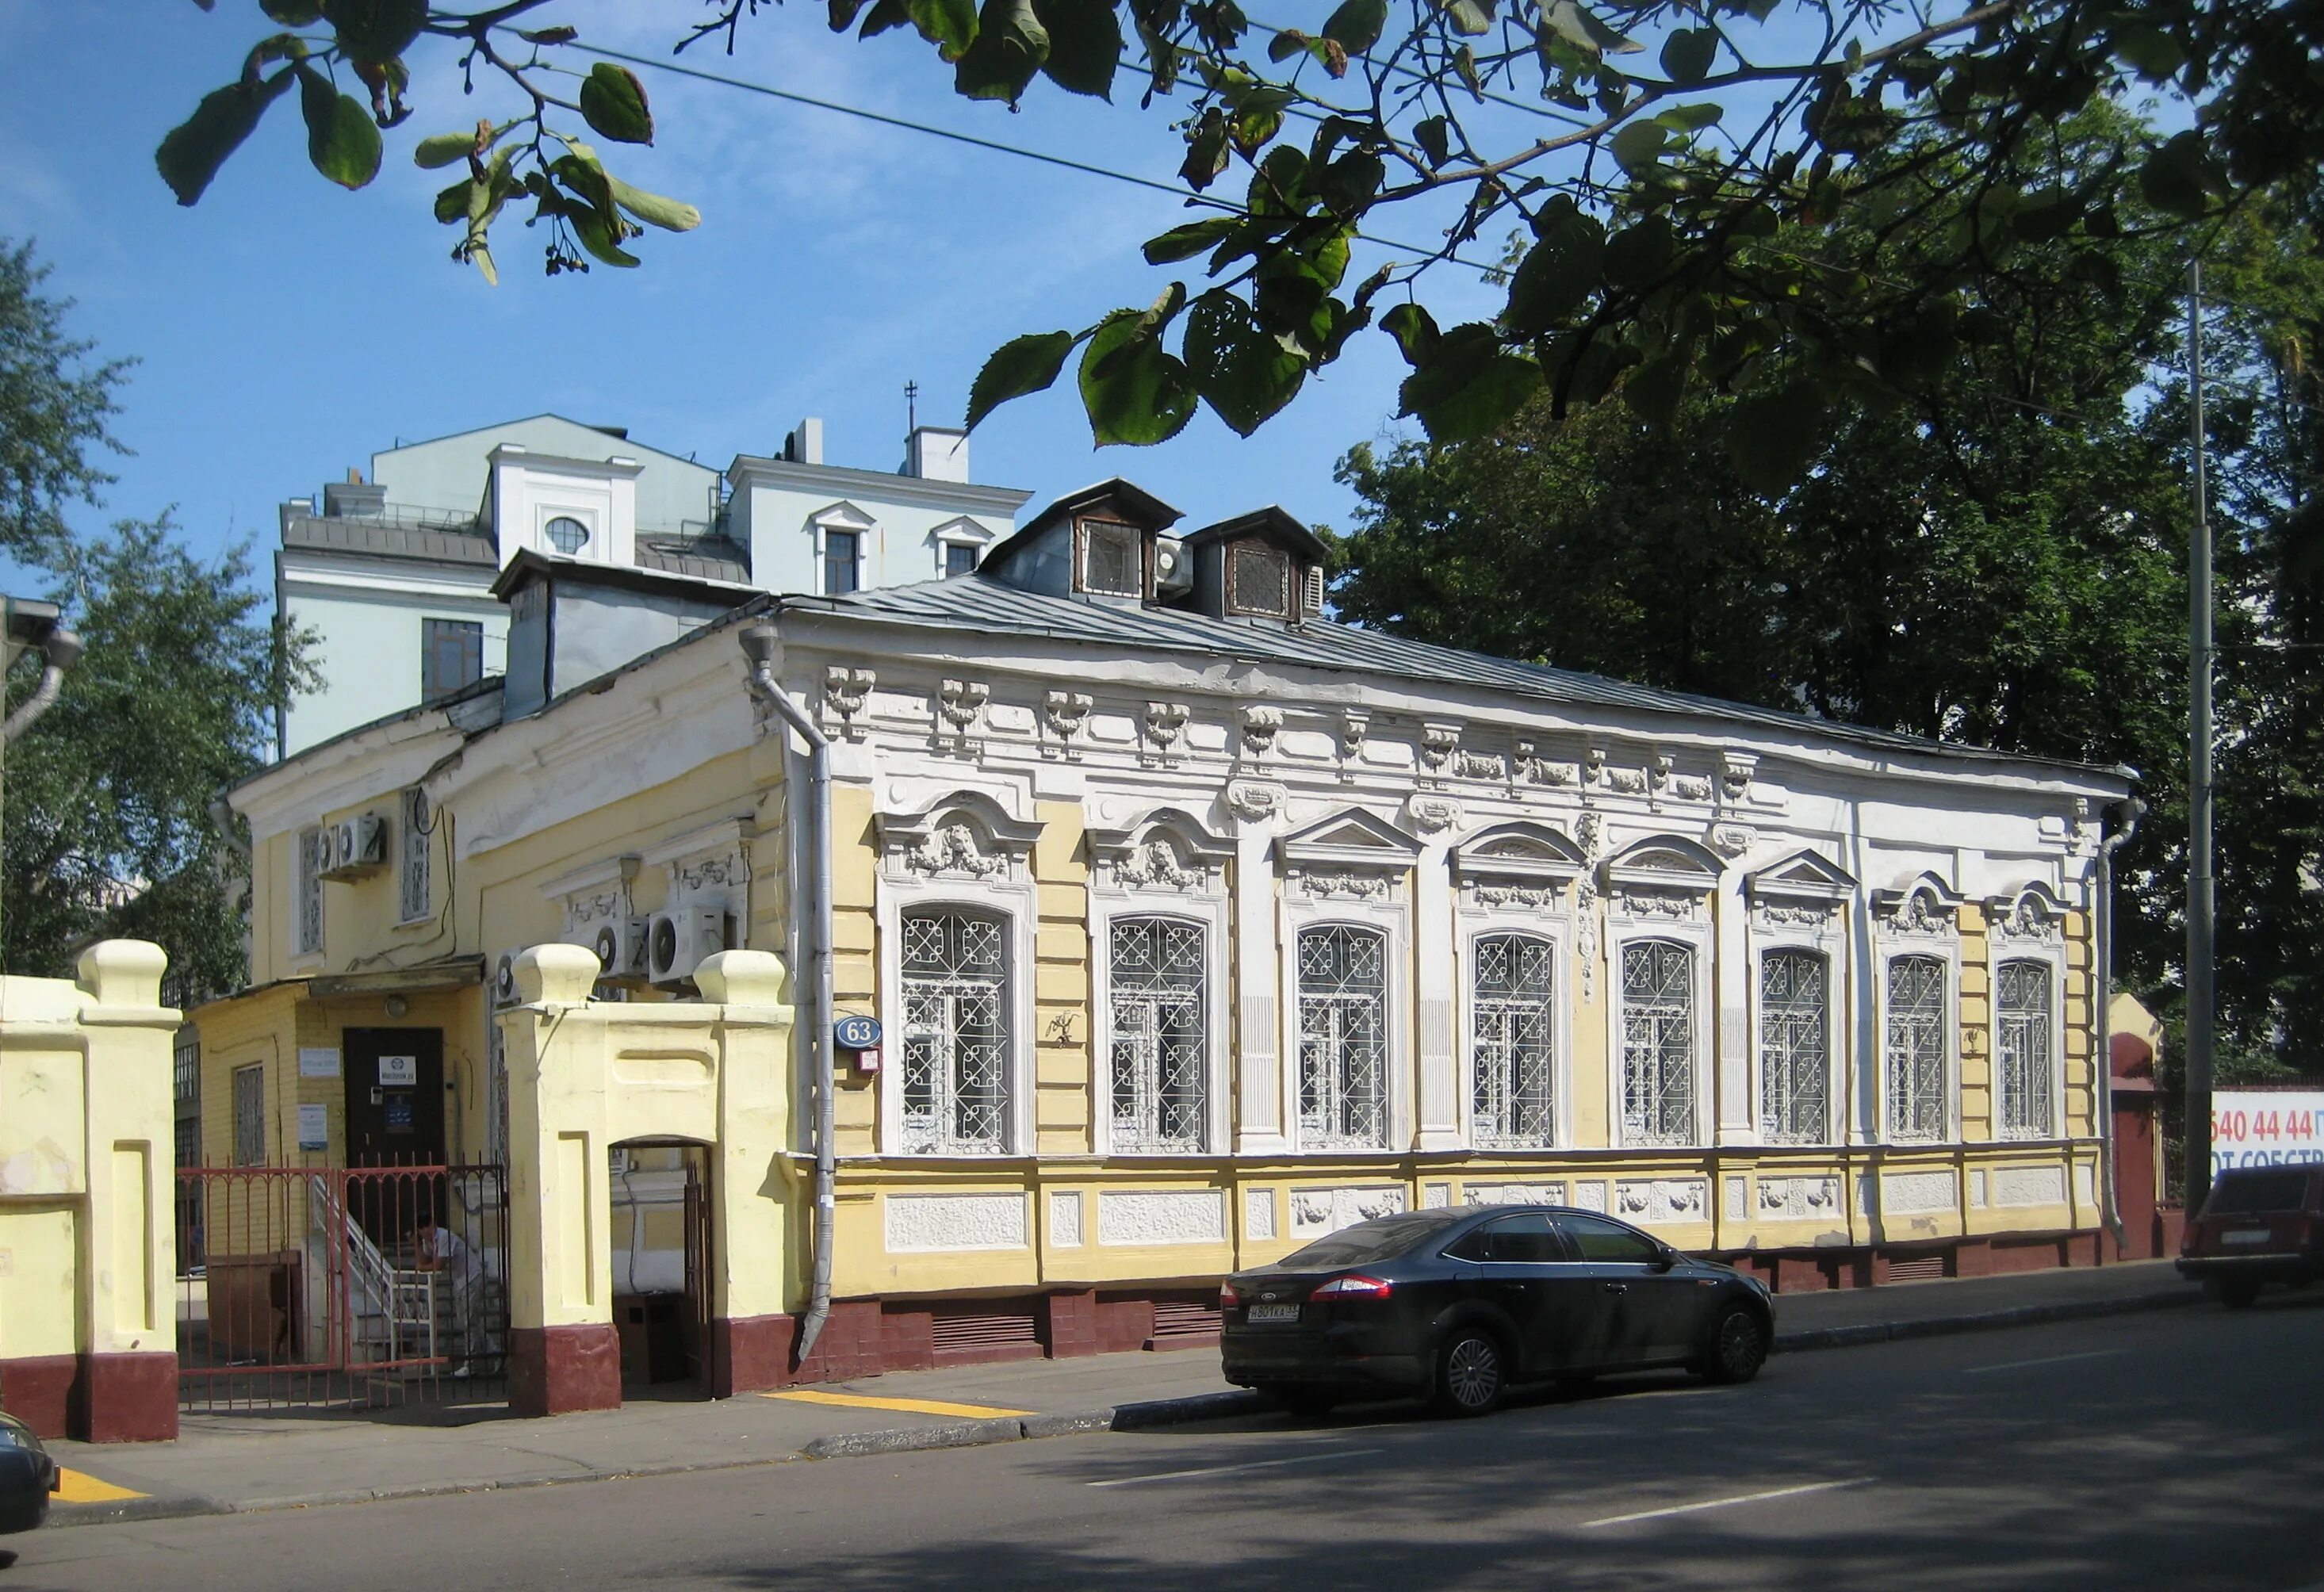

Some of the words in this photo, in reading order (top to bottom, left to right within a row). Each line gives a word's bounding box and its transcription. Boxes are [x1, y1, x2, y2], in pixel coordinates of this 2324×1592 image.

[847, 1021, 871, 1041] 63
[2253, 1110, 2280, 1141] 44
[2285, 1110, 2312, 1141] 44
